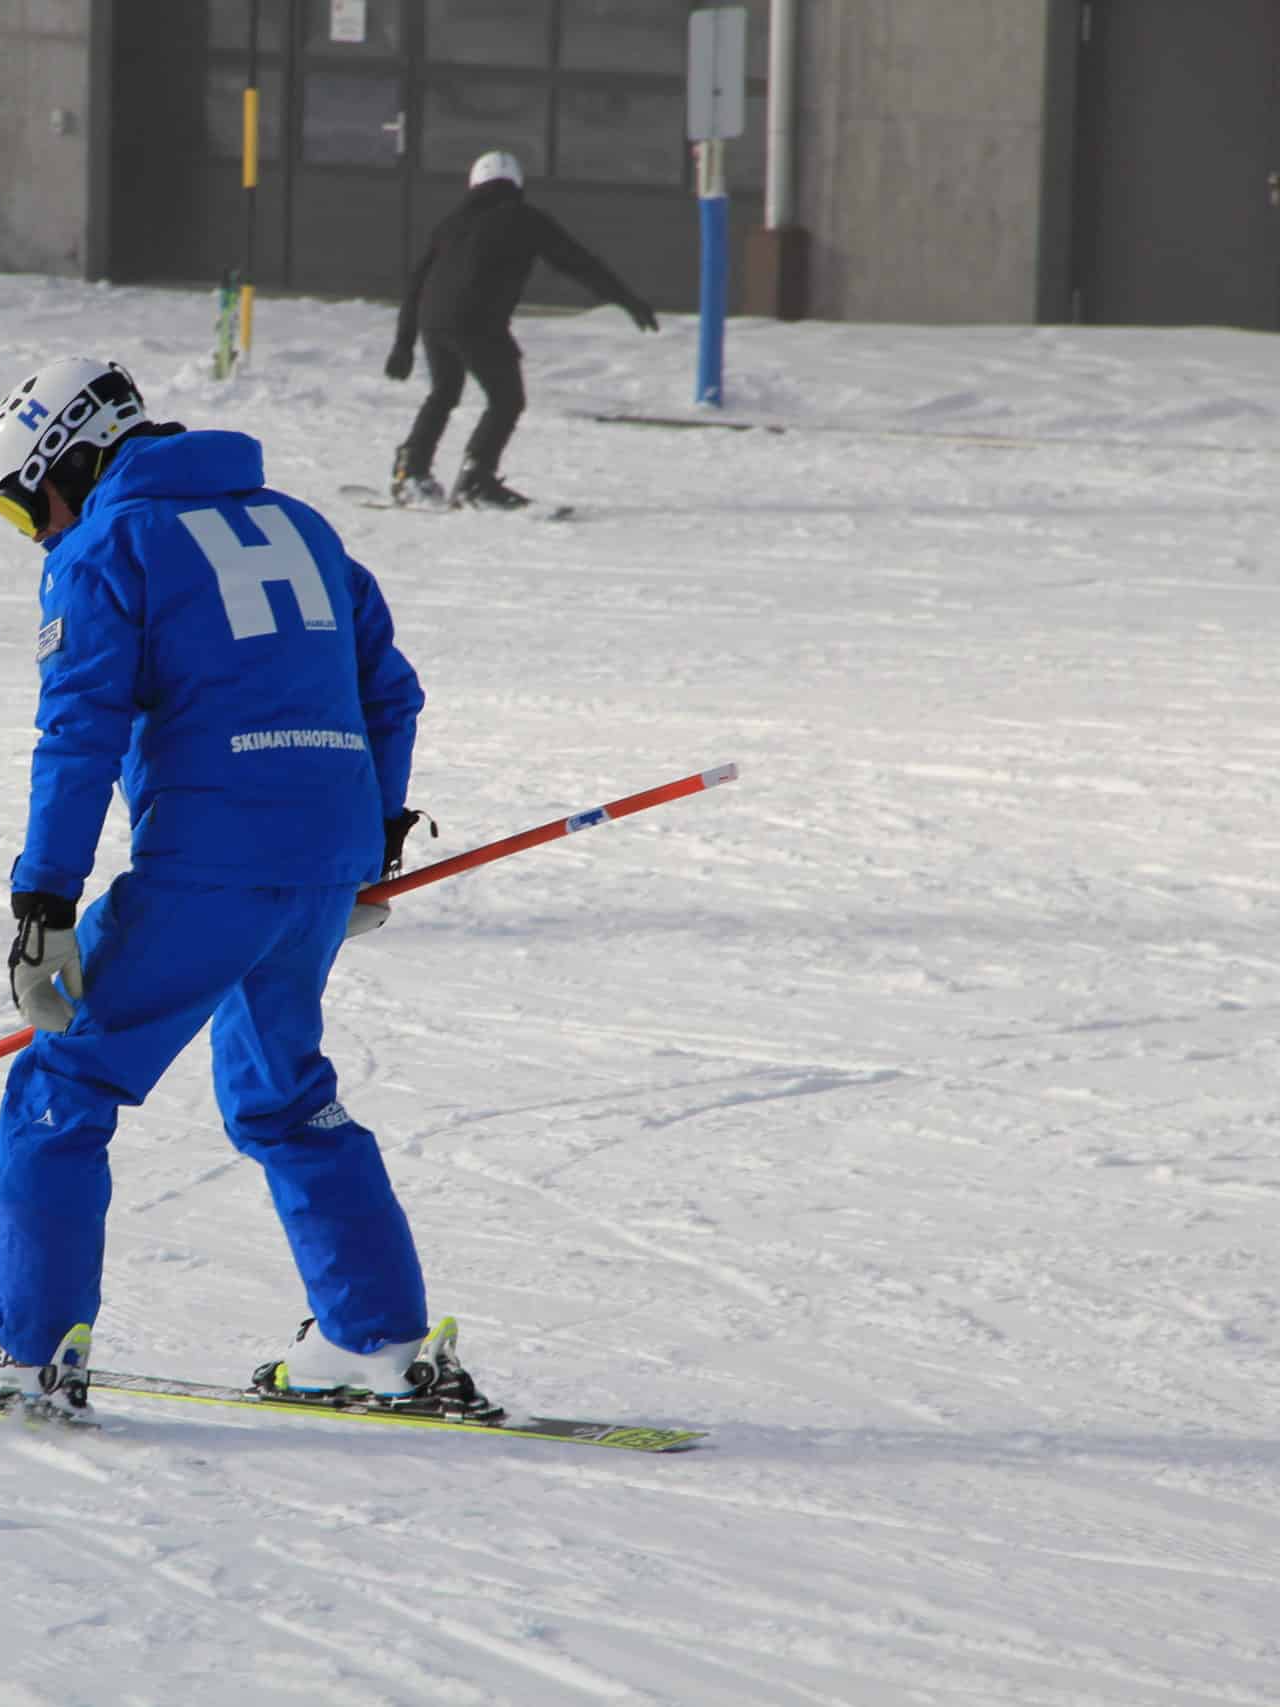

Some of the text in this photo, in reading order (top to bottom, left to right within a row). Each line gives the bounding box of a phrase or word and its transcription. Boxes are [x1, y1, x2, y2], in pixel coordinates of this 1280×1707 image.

[17, 398, 51, 432] H
[19, 397, 94, 493] POC
[177, 504, 338, 641] H
